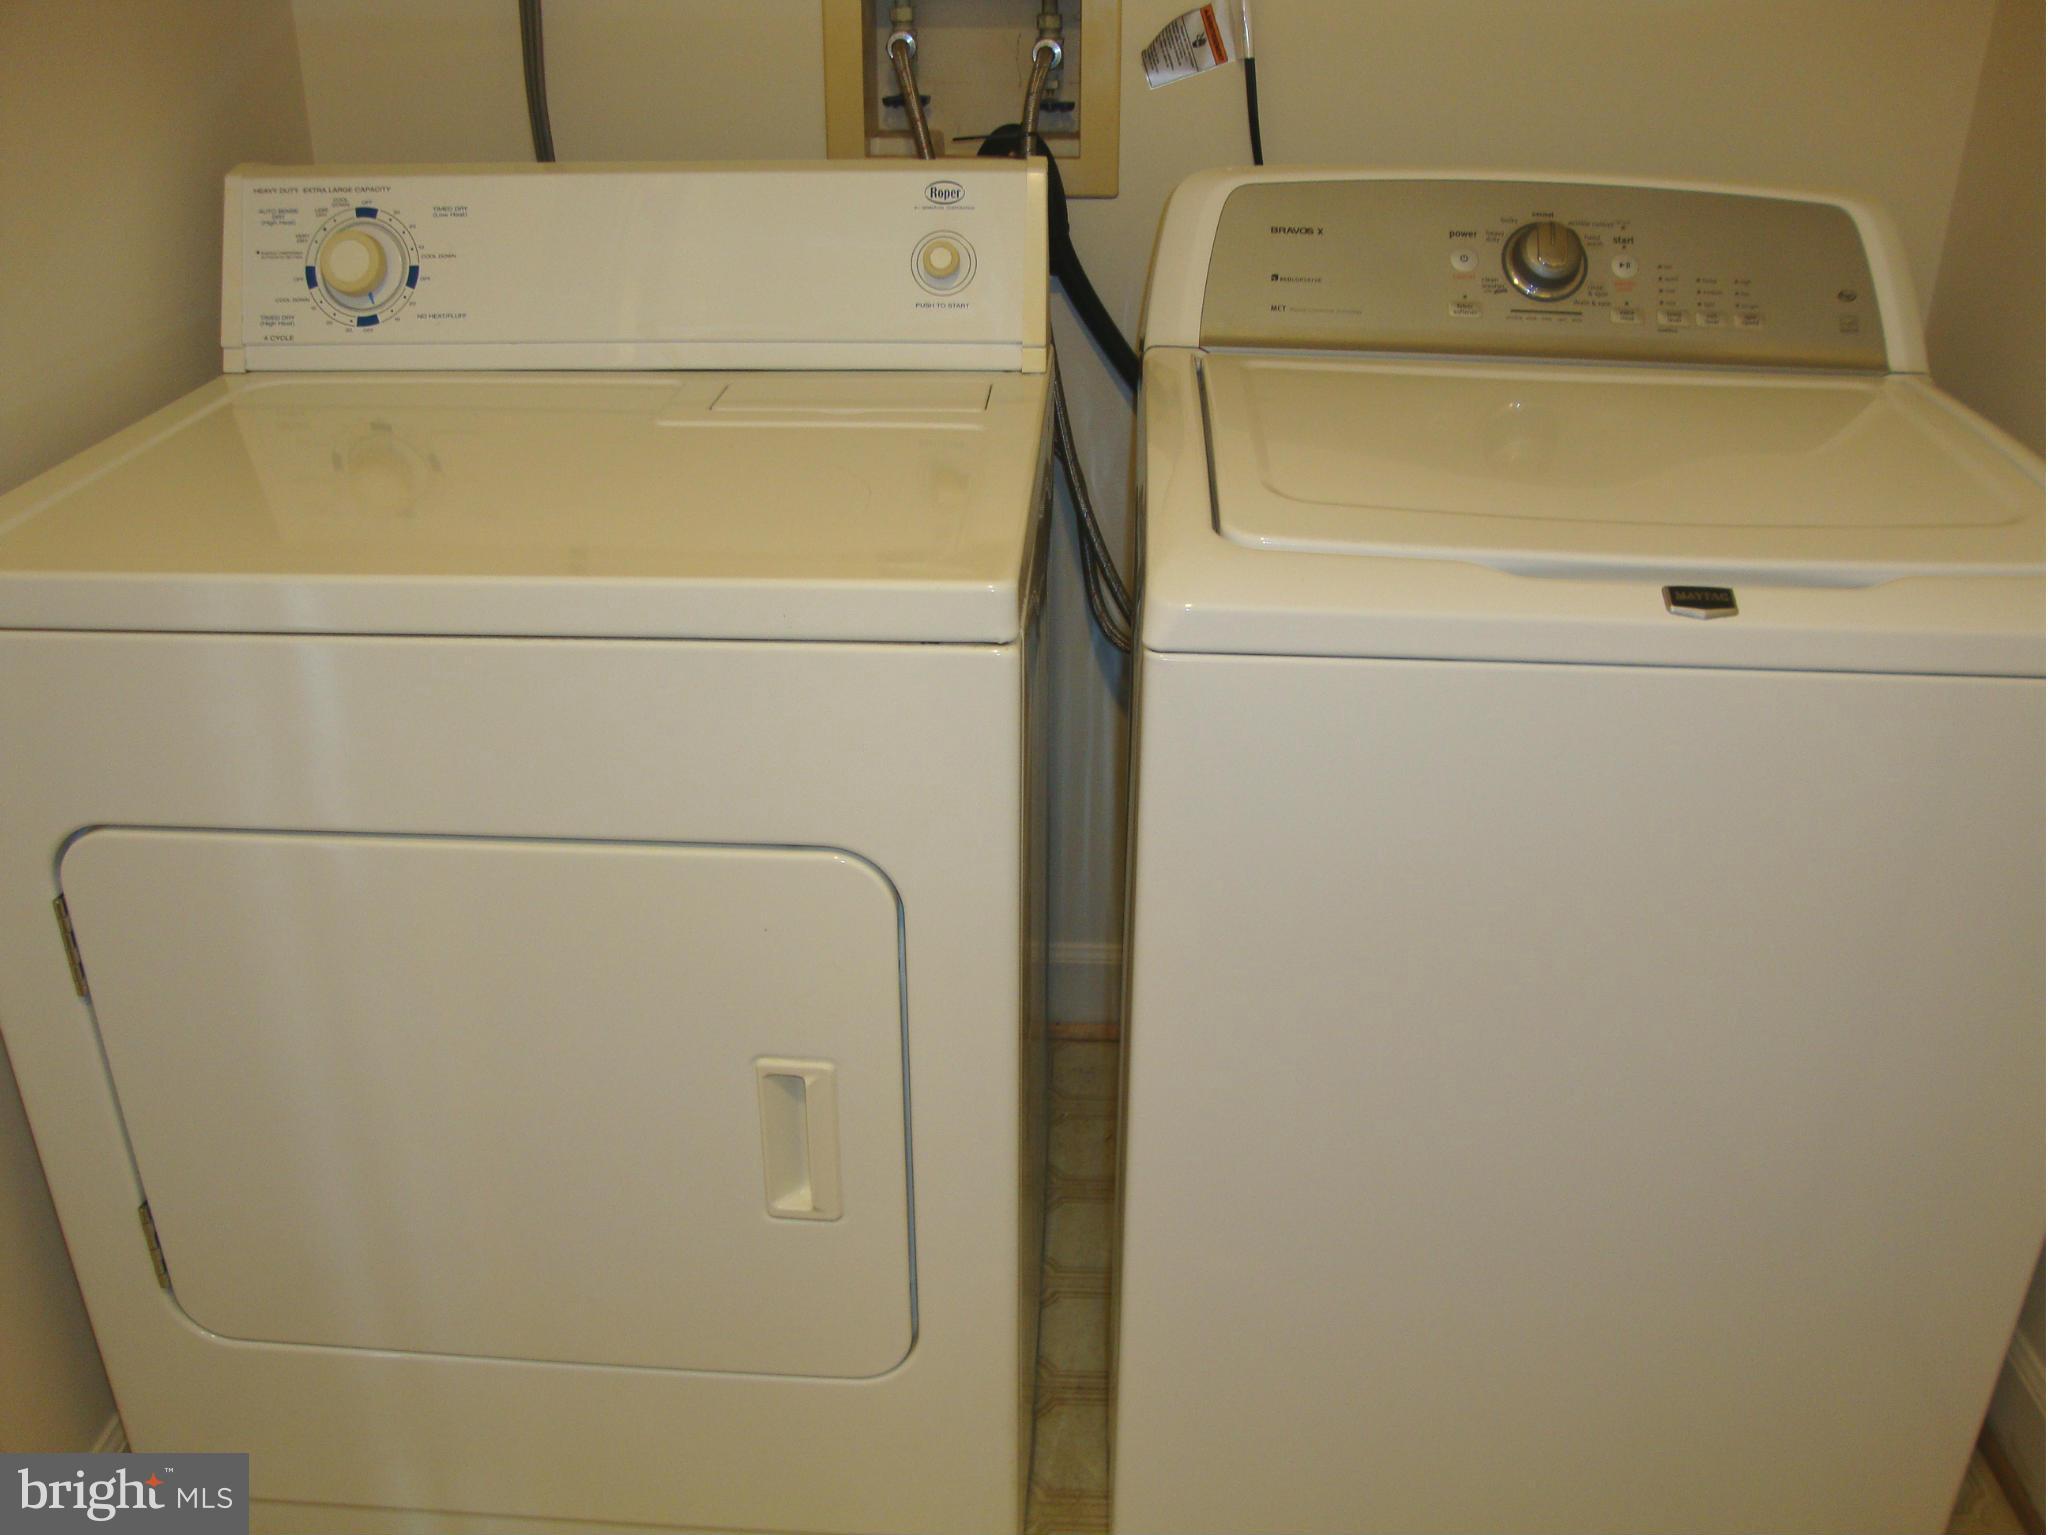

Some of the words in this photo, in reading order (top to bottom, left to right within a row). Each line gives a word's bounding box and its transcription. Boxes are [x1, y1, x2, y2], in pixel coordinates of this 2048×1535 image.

[930, 186, 961, 200] Roper
[1270, 226, 1314, 235] BRAVOS
[1317, 227, 1324, 235] X
[1449, 230, 1477, 239] power
[1613, 235, 1633, 245] start
[1675, 591, 1729, 601] MAYTAG
